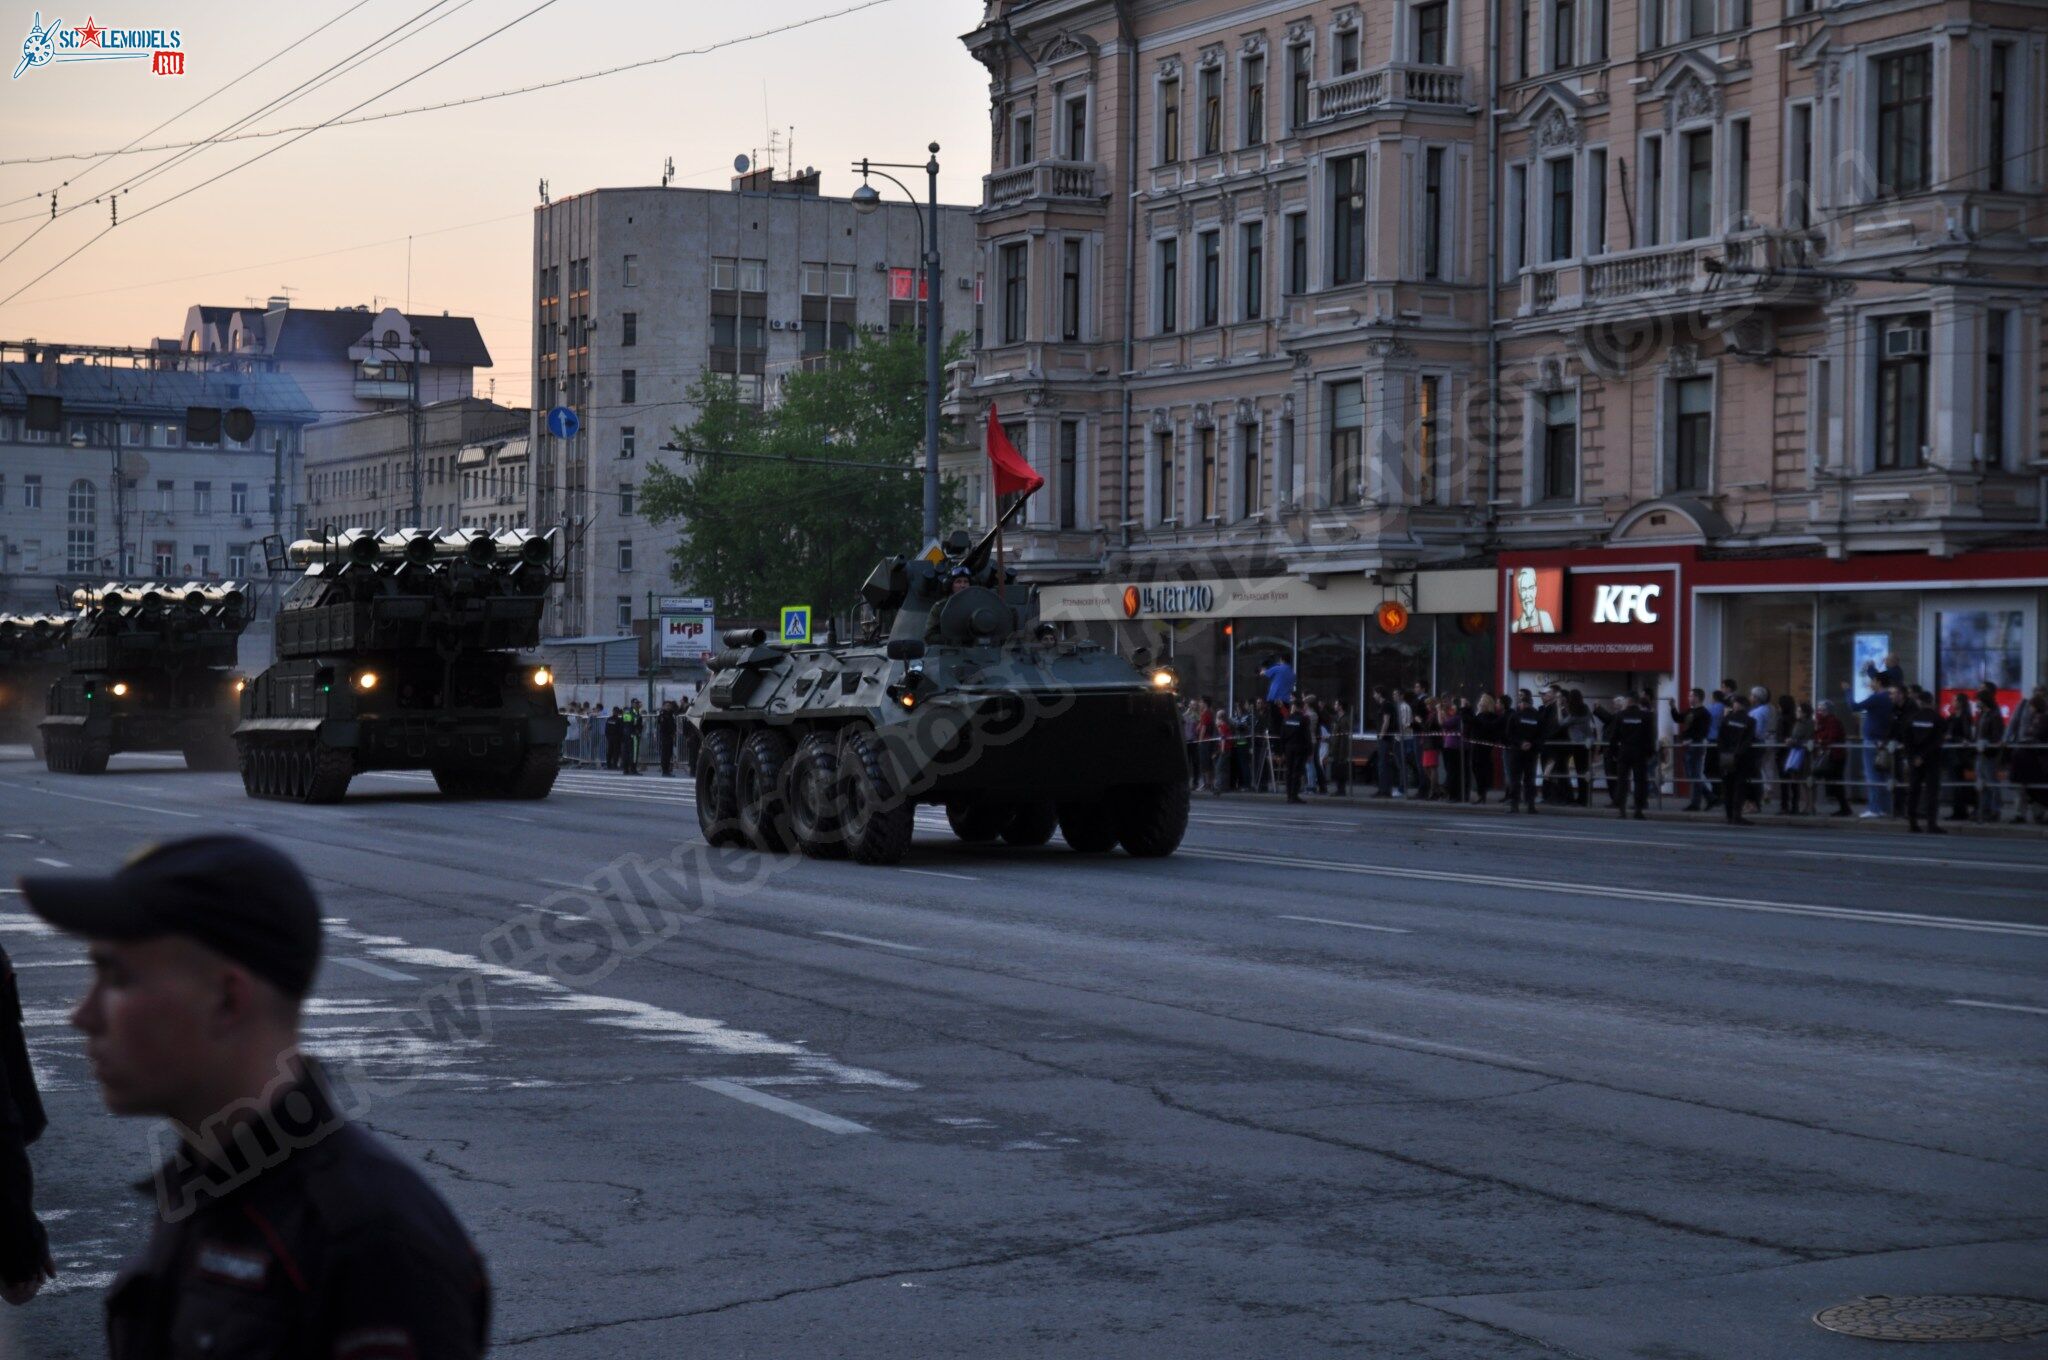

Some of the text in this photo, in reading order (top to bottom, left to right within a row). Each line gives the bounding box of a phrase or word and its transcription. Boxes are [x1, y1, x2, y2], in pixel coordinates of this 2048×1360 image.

[1594, 584, 1660, 623] KFC
[1533, 644, 1573, 653] ПРЕДПРИЯТИЕ
[1574, 644, 1605, 653] БЫСТРОГО
